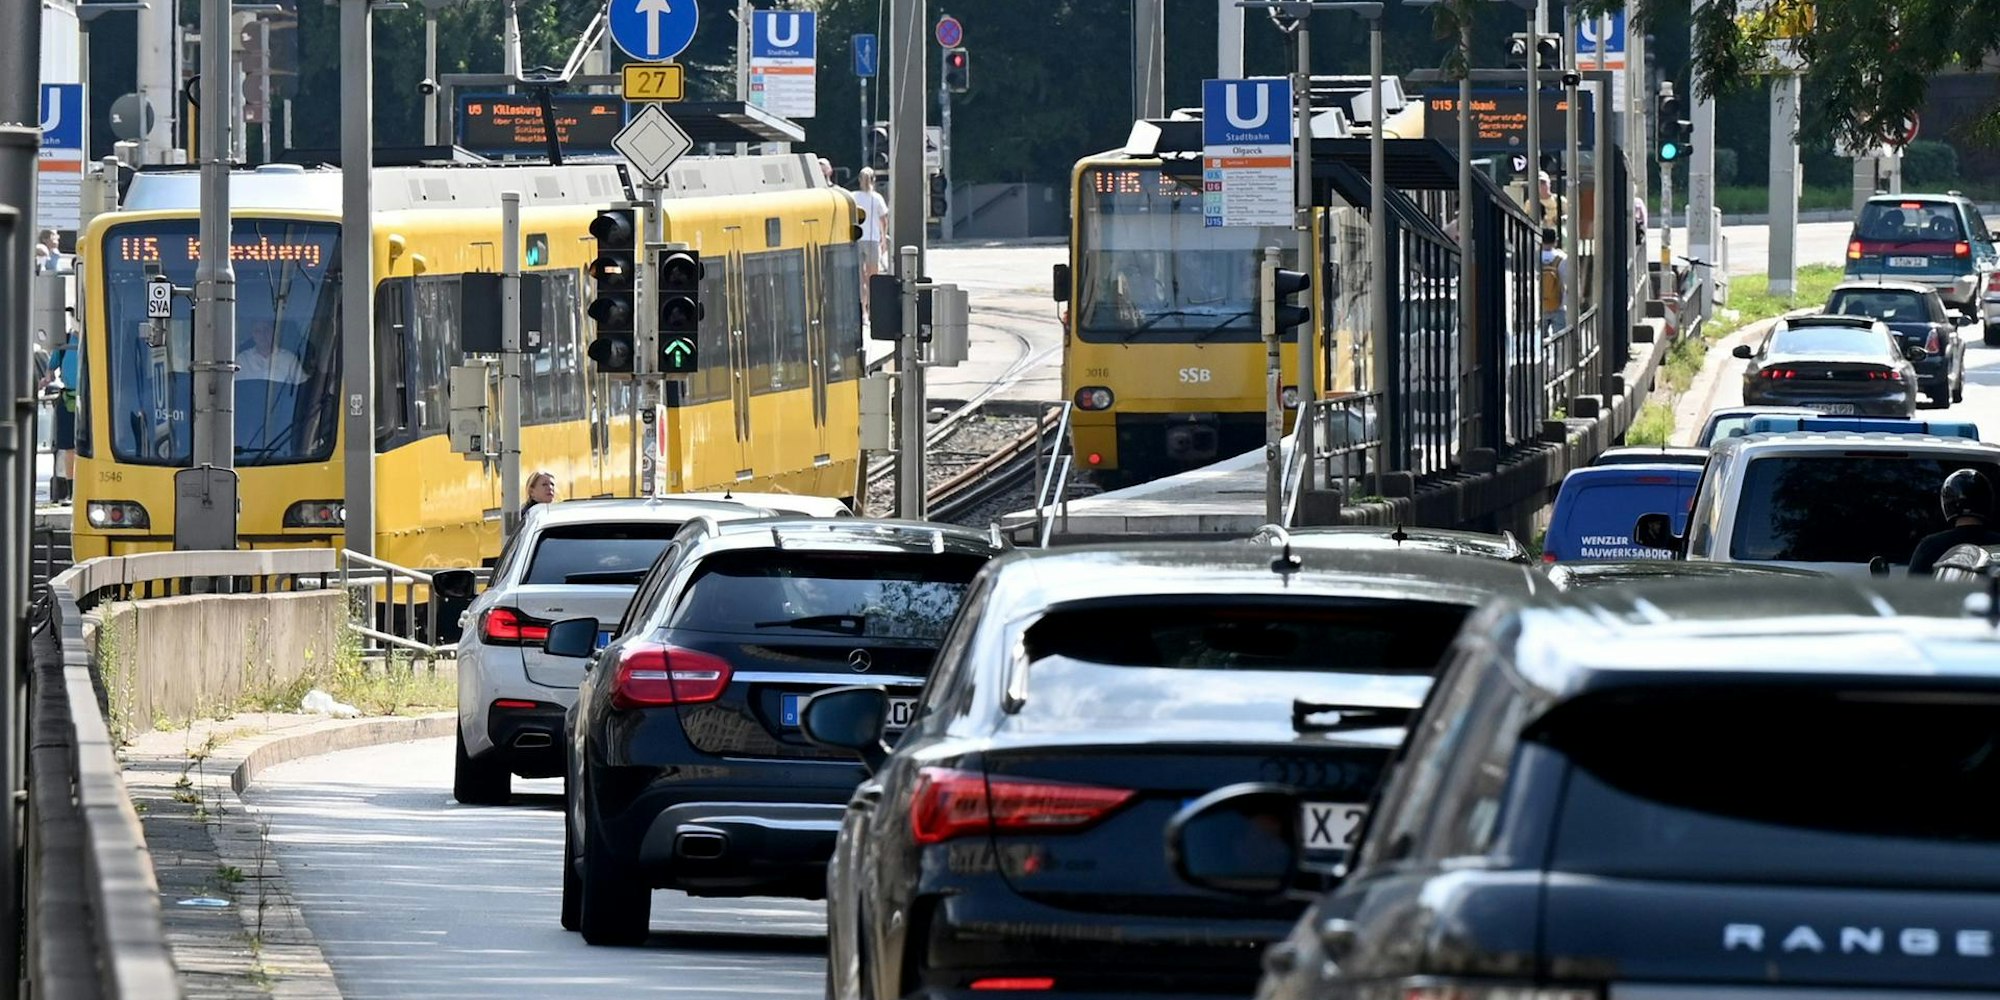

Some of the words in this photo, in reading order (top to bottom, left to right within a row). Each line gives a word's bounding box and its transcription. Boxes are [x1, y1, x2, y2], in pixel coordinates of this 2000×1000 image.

[767, 13, 799, 47] U
[637, 71, 667, 93] 27
[468, 104, 482, 115] U5
[493, 104, 542, 117] Killesberg
[1225, 83, 1269, 129] U
[1431, 100, 1452, 111] U15
[1225, 132, 1269, 141] Stadtbahn
[1232, 146, 1262, 156] Olgaeck
[122, 237, 158, 261] U5
[188, 237, 320, 268] Kesberg
[150, 300, 169, 313] SVA
[1179, 368, 1211, 383] SSB
[99, 471, 122, 482] 3546
[1581, 536, 1628, 546] WENZLER
[1310, 808, 1332, 843] X
[1723, 923, 1993, 957] RANGE
